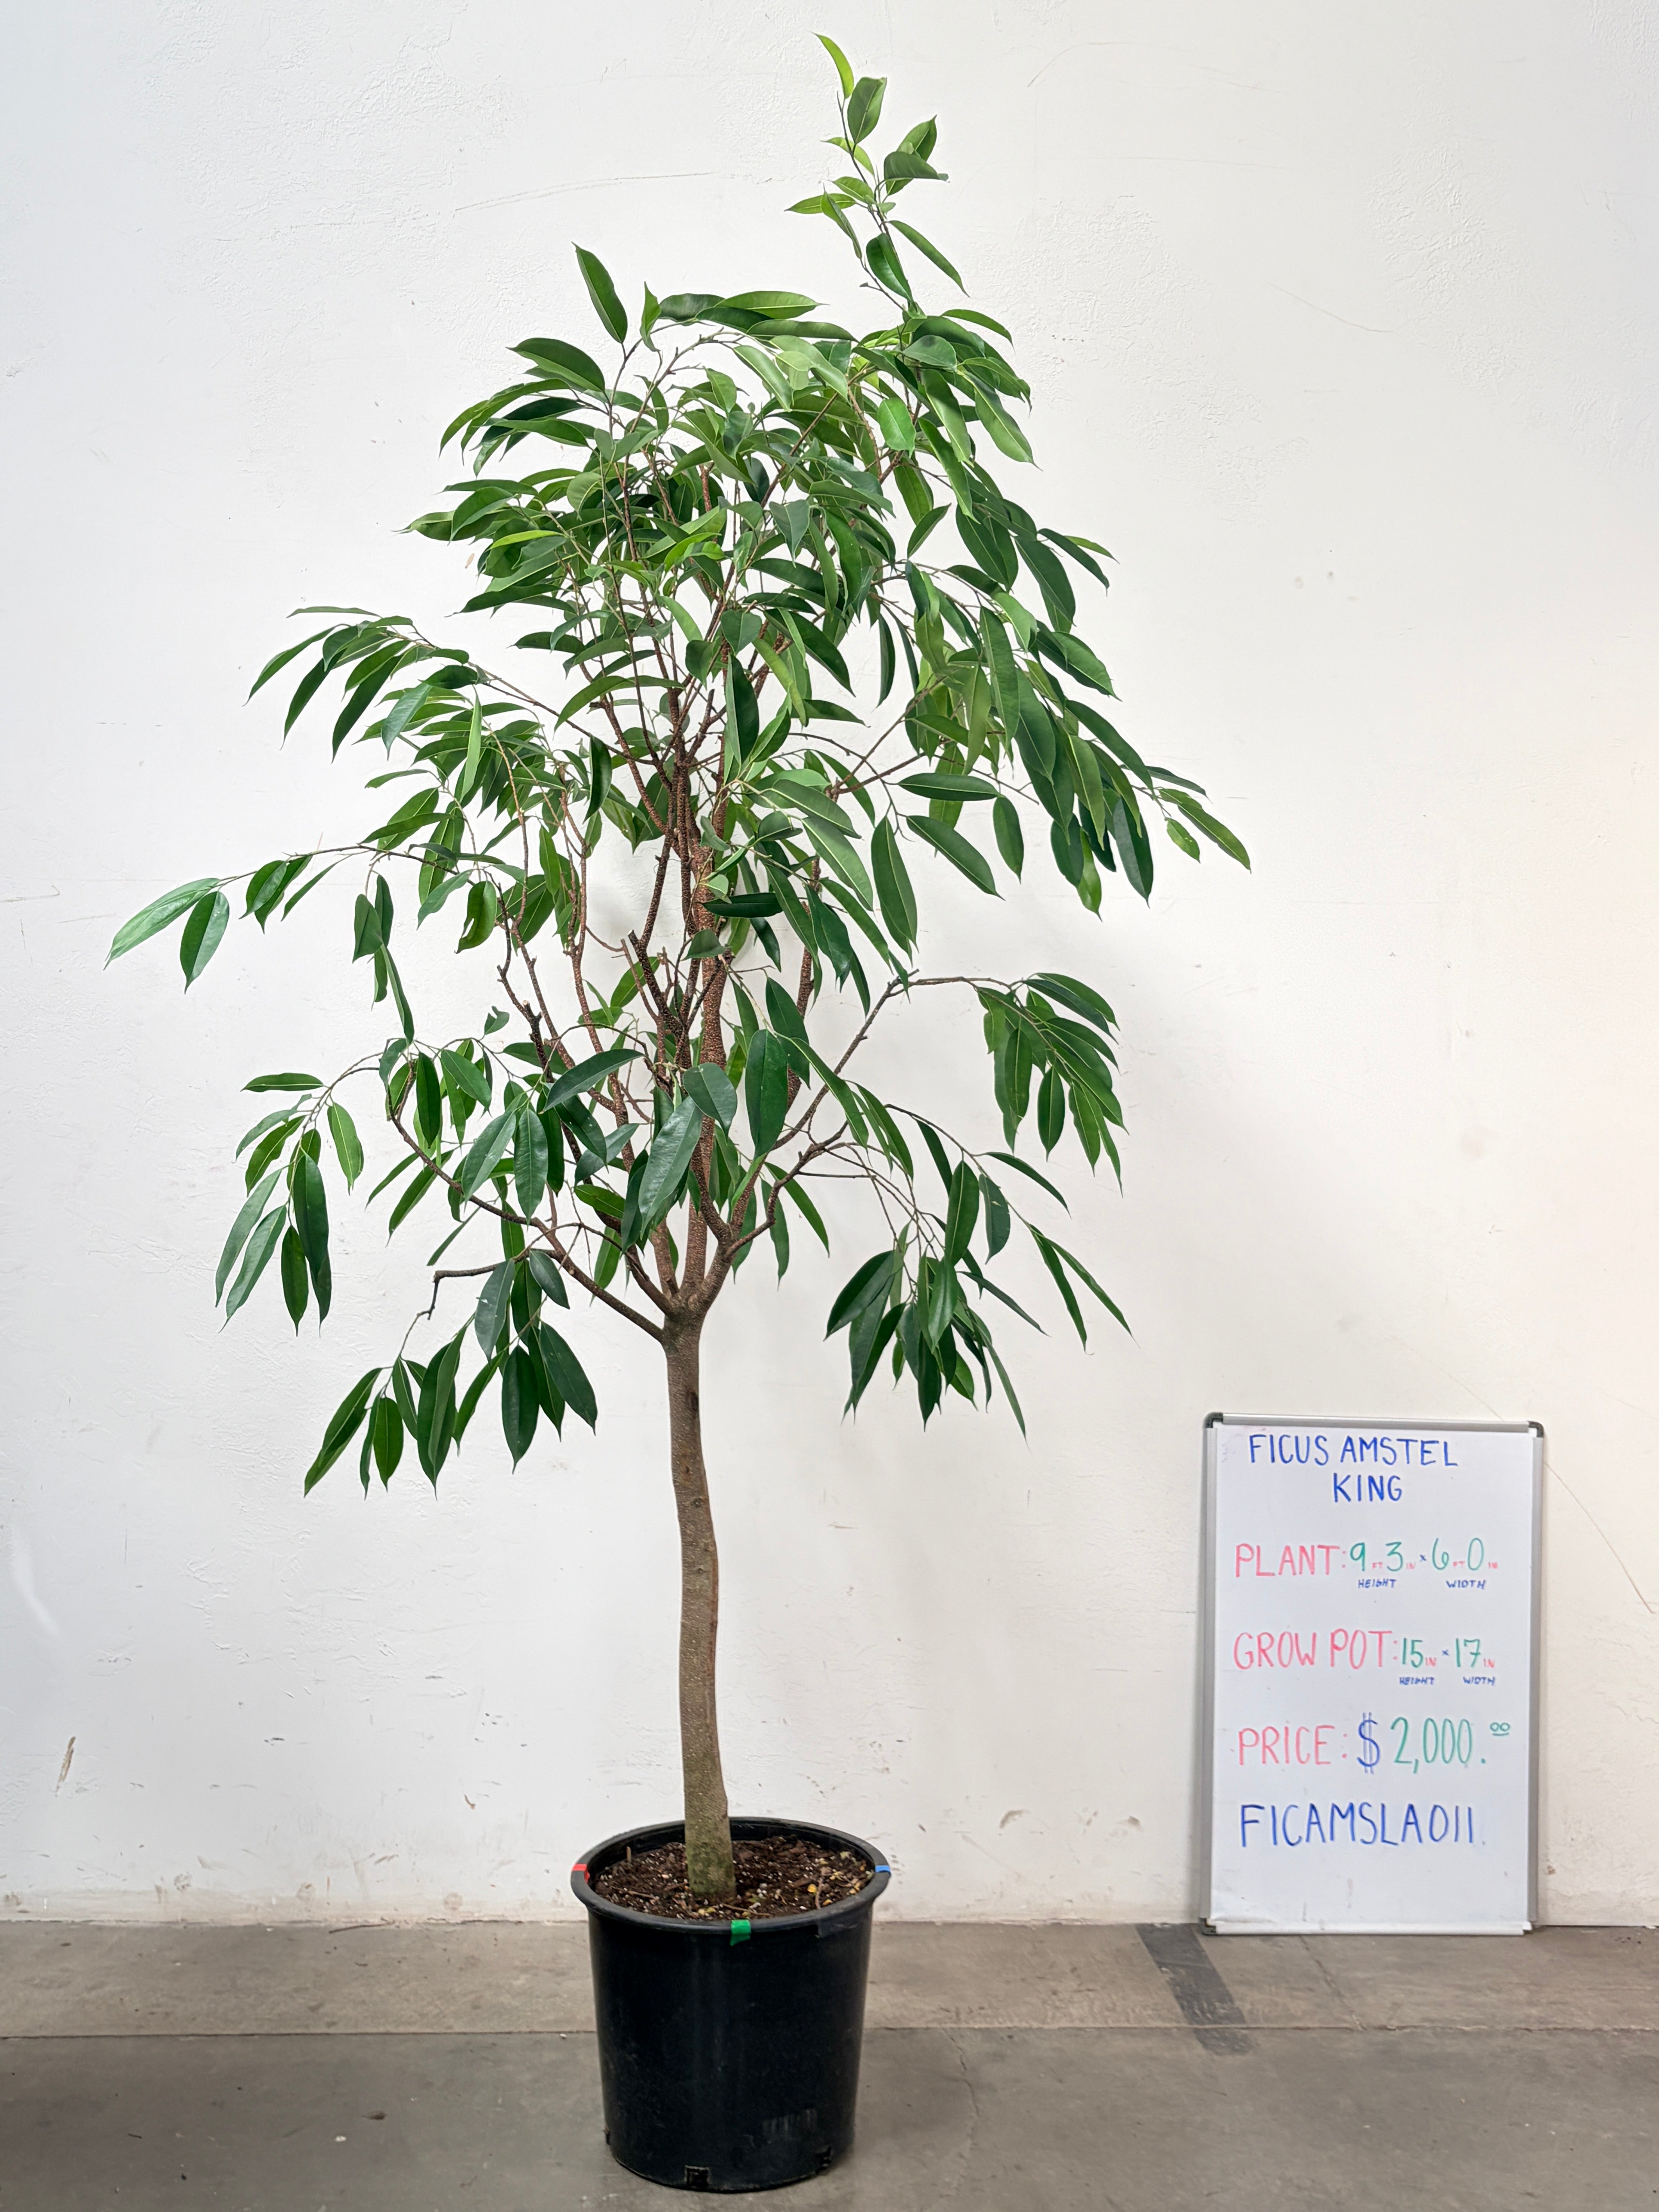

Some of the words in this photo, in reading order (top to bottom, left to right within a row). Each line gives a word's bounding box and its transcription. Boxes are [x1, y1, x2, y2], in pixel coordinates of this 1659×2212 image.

[1249, 1433, 1329, 1466] FICUS
[1340, 1435, 1459, 1467] AMSTEL
[1333, 1472, 1402, 1503] KING
[1358, 1578, 1397, 1589] HEIGHT
[1446, 1579, 1487, 1590] WIDTH
[1233, 1631, 1317, 1670] GROW
[1399, 1676, 1435, 1686] HEIGHT
[1462, 1676, 1496, 1686] WIDTH
